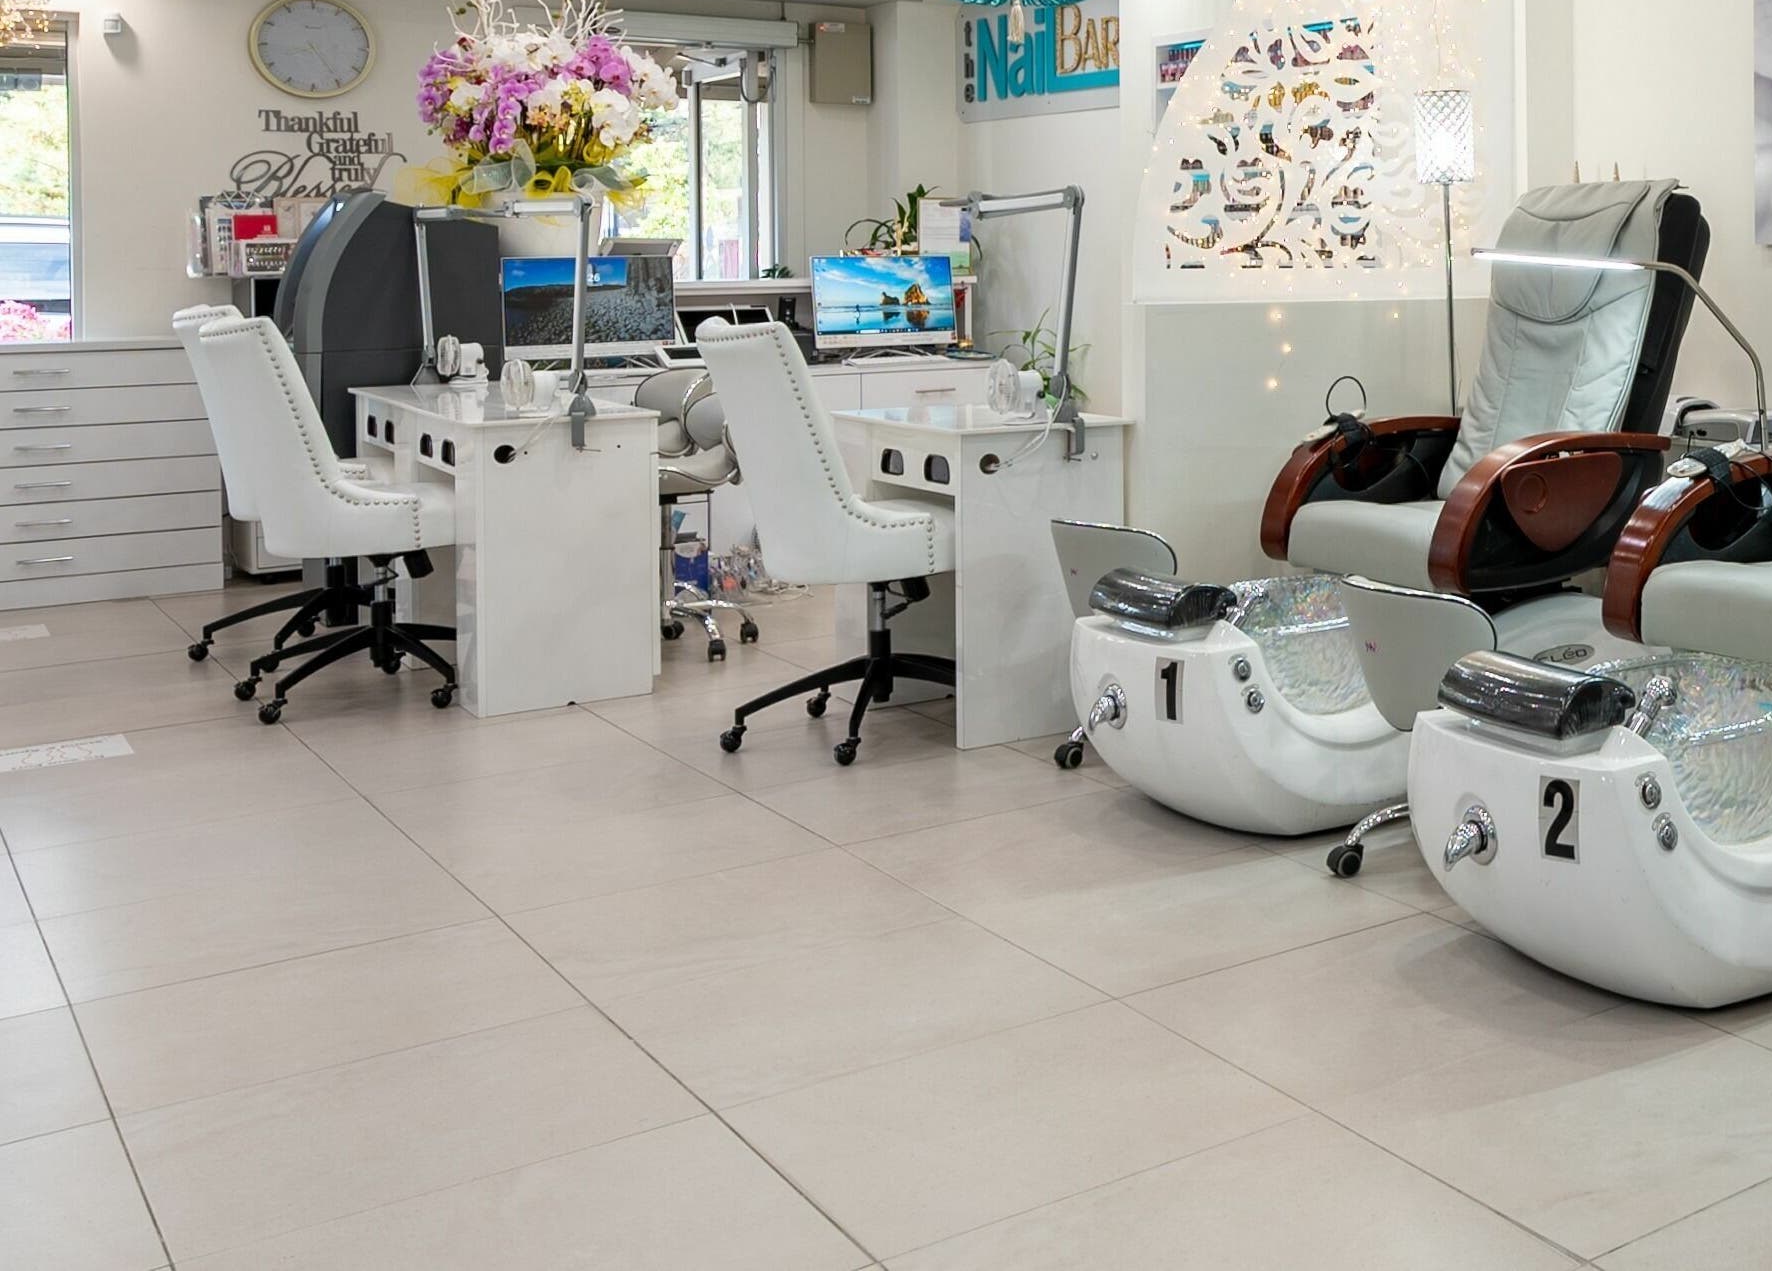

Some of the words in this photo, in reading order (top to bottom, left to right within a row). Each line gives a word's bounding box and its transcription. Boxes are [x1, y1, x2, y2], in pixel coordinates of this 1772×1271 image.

[964, 20, 976, 104] the
[258, 110, 361, 133] Thankful
[306, 132, 394, 155] Grateful
[333, 155, 361, 167] and
[330, 163, 384, 187] truly
[1161, 661, 1178, 720] 1
[1543, 779, 1575, 860] 2
